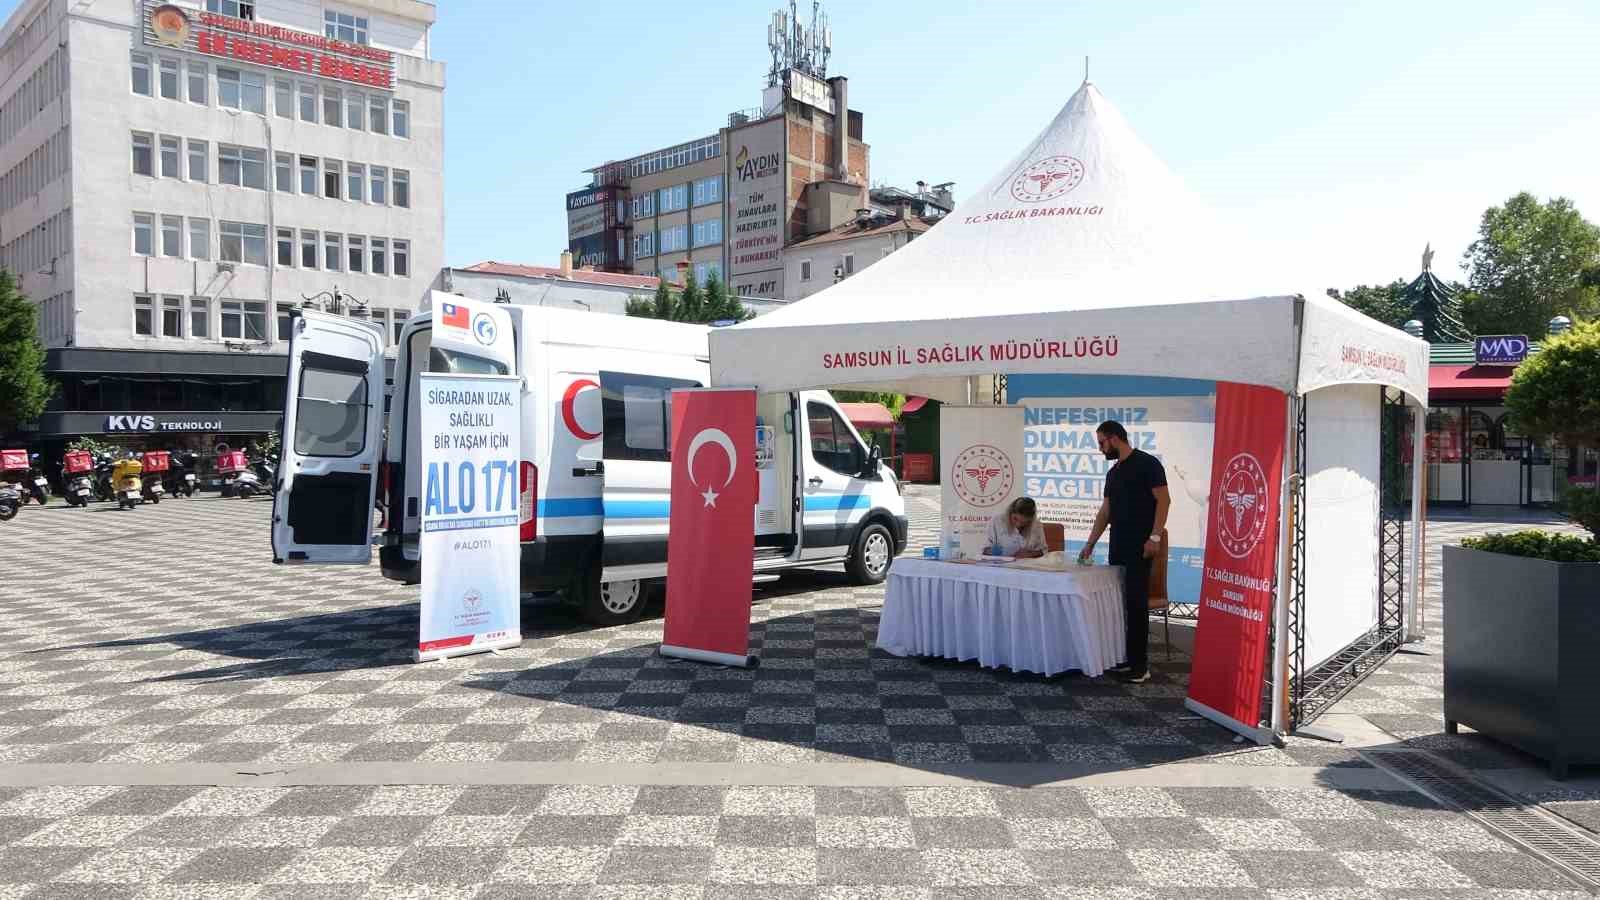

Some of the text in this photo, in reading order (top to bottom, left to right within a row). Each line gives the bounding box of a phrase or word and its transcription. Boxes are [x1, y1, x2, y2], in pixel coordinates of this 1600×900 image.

[743, 151, 779, 182] AYDIN
[738, 203, 777, 219] SINAVLARA
[984, 209, 1027, 222] SAĞLIK
[1030, 204, 1104, 218] BAKANLIĞI
[758, 281, 776, 294] AYT
[823, 335, 1119, 369] SAMSUN İL SAĞLIK MÜDÜRLÜĞÜ
[1480, 338, 1525, 356] MAD
[428, 388, 484, 405] SİGARADAN
[109, 415, 222, 430] KVS TEKNOLOJİ
[450, 411, 494, 428] SAĞLIKLI
[434, 432, 509, 451] BİR YAŞAM İÇİN
[1024, 431, 1157, 449] DUMAIZ
[425, 459, 518, 516] ALO 171
